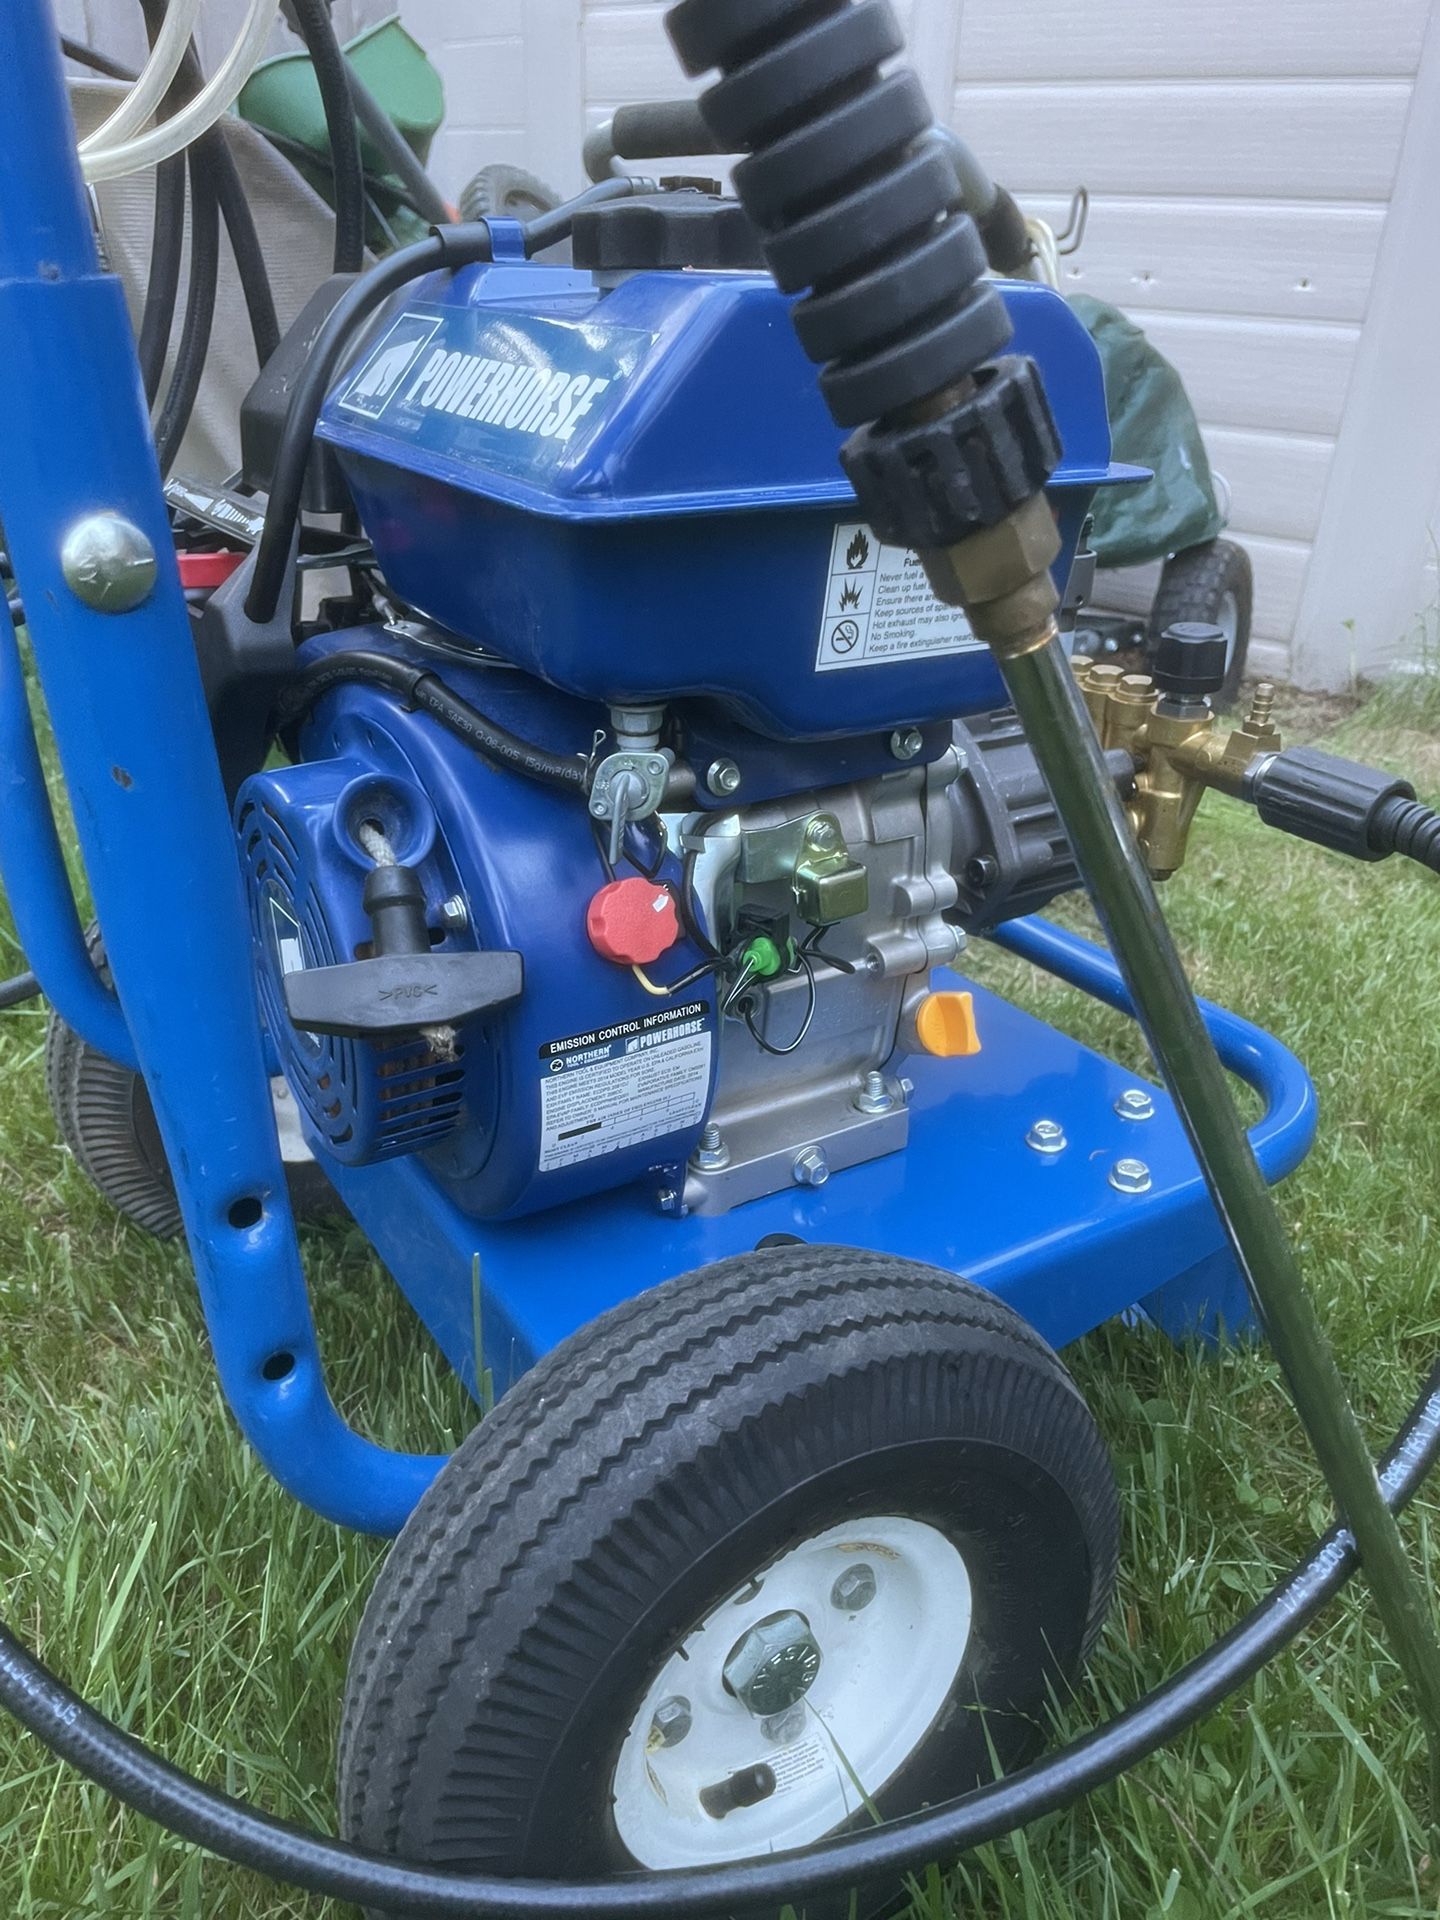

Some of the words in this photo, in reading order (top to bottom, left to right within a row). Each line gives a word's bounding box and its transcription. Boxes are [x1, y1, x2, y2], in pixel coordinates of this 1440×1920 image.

[405, 349, 610, 440] POWERHORSE
[880, 573, 903, 582] Never
[904, 571, 918, 579] fuel
[878, 585, 900, 594] Clean
[902, 584, 911, 593] up
[912, 582, 927, 591] fuel
[876, 597, 903, 606] Ensure
[905, 594, 924, 604] there
[874, 608, 894, 618] Keep
[896, 605, 925, 615] sources
[926, 604, 933, 612] of
[873, 620, 885, 629] Hot
[887, 617, 916, 628] exhaust
[918, 616, 933, 627] may
[934, 614, 949, 624] also
[869, 643, 888, 653] Keep
[896, 641, 908, 649] fire
[910, 636, 951, 650] extinguisher
[871, 633, 881, 641] No
[550, 1033, 595, 1054] EMISSION
[598, 1022, 641, 1041] CONTROL
[643, 1003, 702, 1028] INFORMATION
[640, 1019, 703, 1047] POWERHORSE
[566, 1046, 610, 1065] NORTHERN
